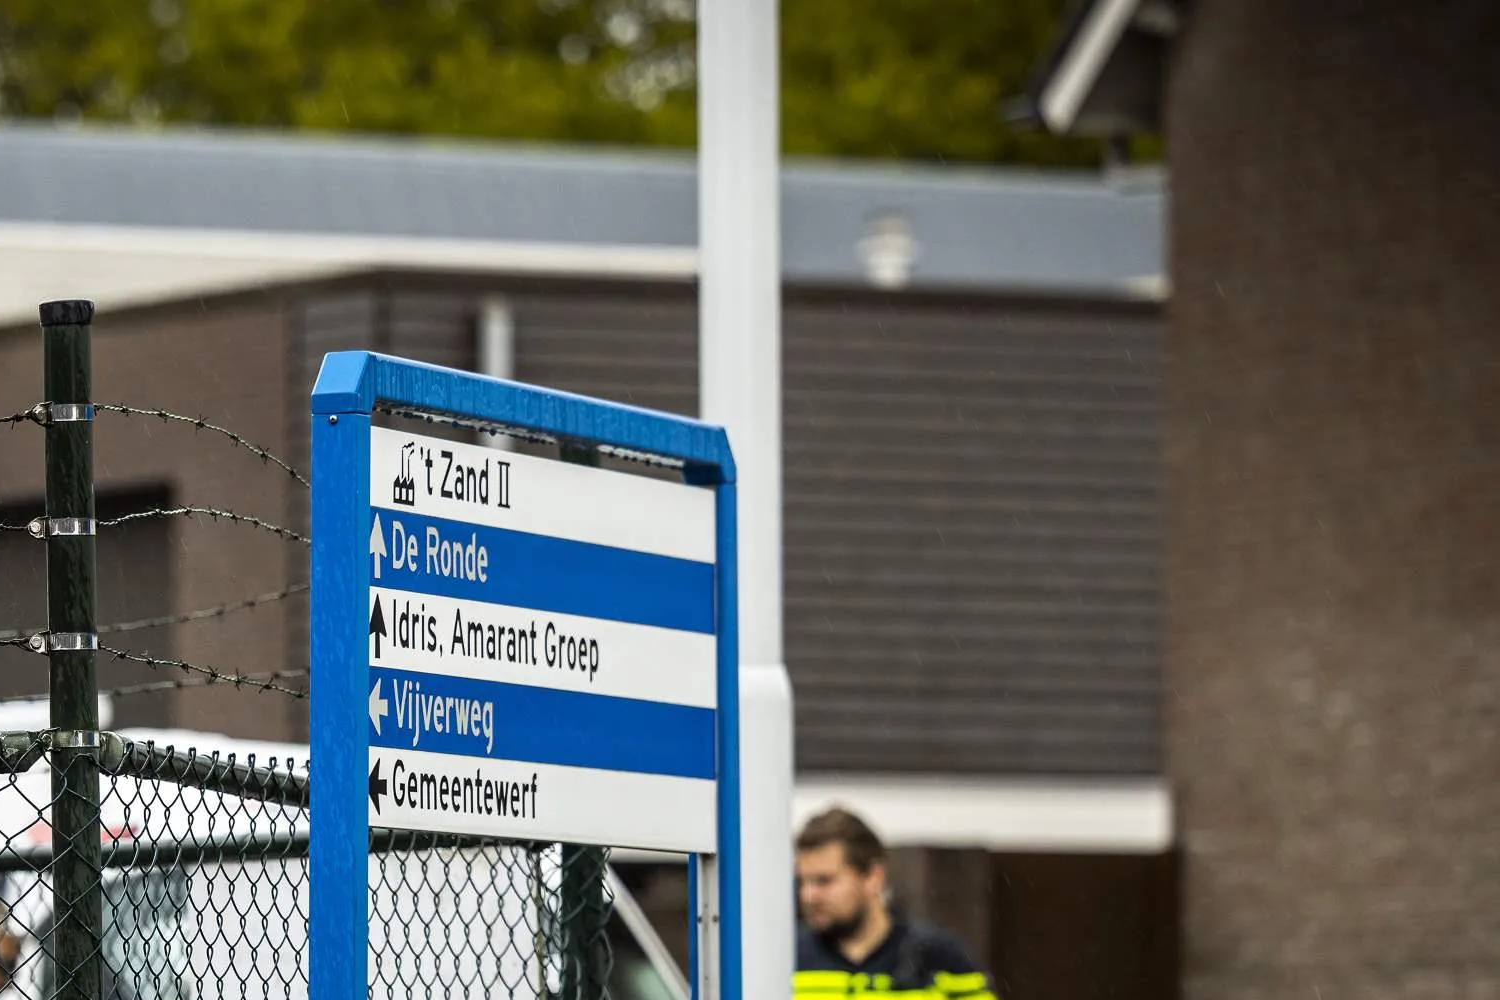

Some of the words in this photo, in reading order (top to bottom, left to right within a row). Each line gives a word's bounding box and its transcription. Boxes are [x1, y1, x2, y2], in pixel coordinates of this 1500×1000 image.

[440, 449, 489, 506] Zand
[392, 520, 419, 573] De
[426, 526, 489, 583] Ronde
[392, 598, 443, 657] Idris,
[451, 607, 538, 666] Amarant
[544, 621, 600, 683] Groep
[393, 678, 494, 755] Vijverweg
[392, 758, 538, 819] Gemeentewerf
